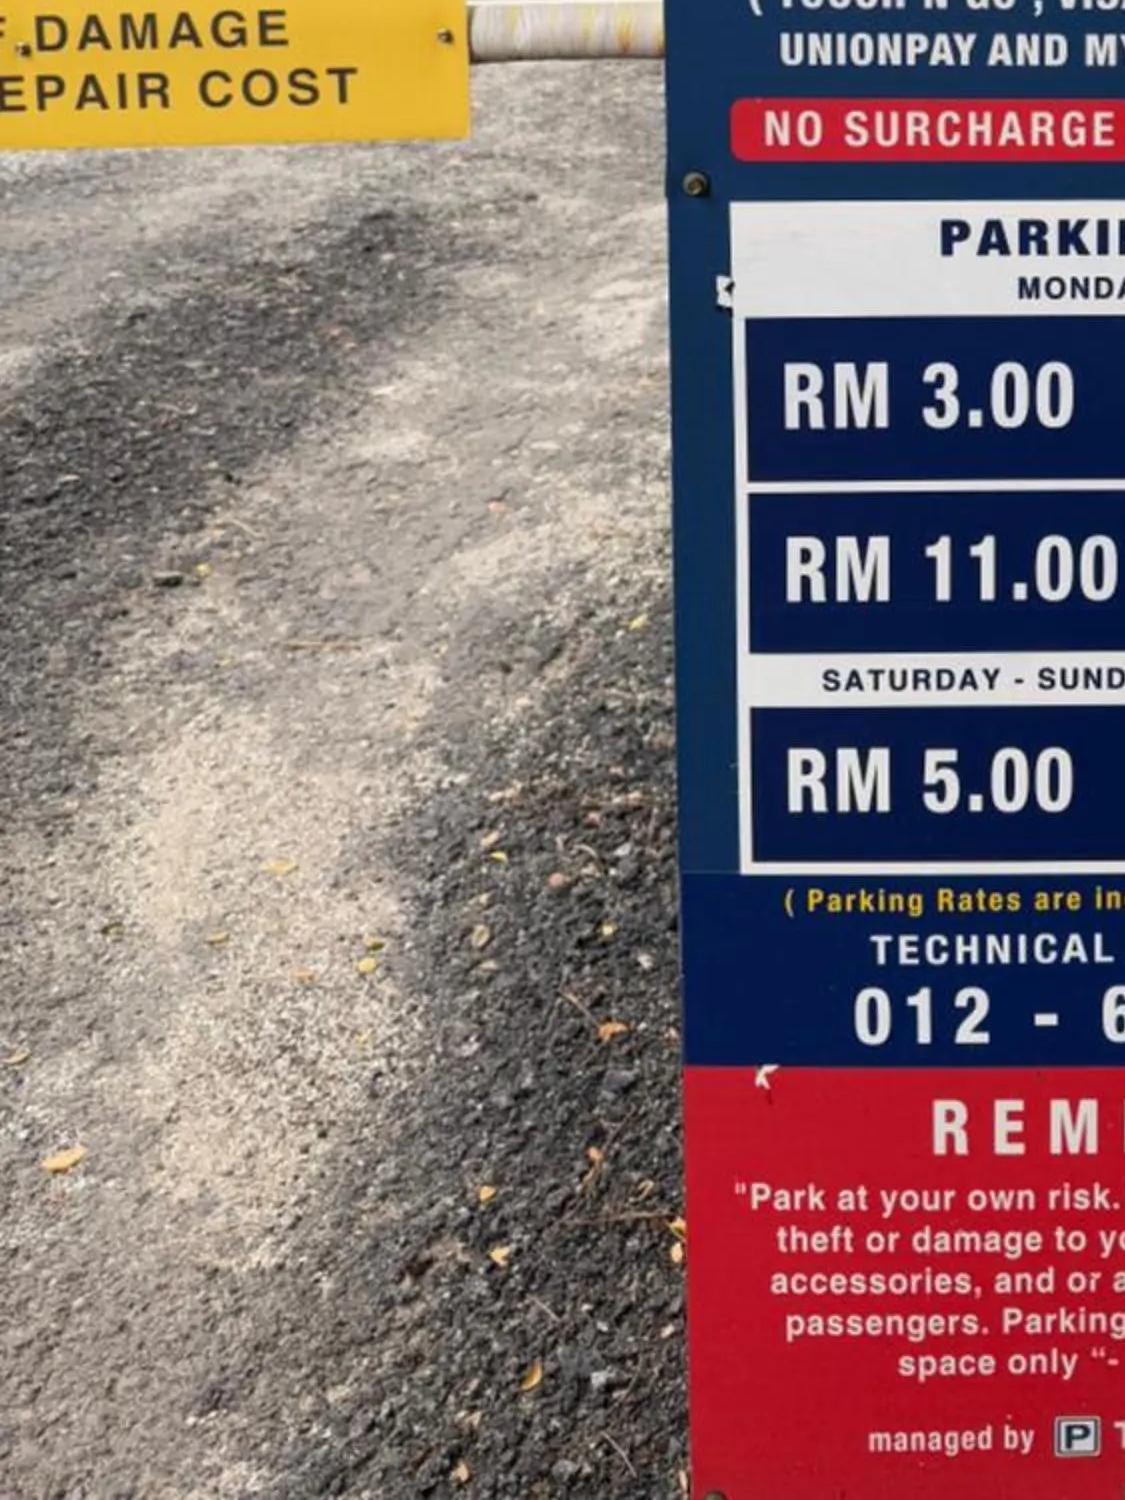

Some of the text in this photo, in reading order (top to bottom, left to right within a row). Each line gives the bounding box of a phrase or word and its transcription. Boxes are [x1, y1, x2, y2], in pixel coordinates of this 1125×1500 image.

[35, 10, 289, 52] DAMAGE
[780, 32, 977, 66] UNIONPAY
[987, 33, 1068, 67] AND
[198, 68, 357, 108] COST
[765, 110, 1115, 148] NO SURCHARGE
[783, 361, 1074, 430] RM 3.00
[786, 534, 1118, 603] RM 11.00
[822, 667, 1000, 692] SATURDAY
[787, 747, 1073, 814] RM 5.00
[807, 888, 923, 917] Parking
[937, 887, 1021, 912] Rates
[1034, 891, 1081, 911] are
[869, 932, 1115, 965] TECHNICAL
[854, 986, 990, 1046] 012
[837, 1185, 868, 1211] at
[880, 1189, 956, 1219] your
[967, 1189, 1035, 1211] own
[1048, 1182, 1120, 1211] risk.
[776, 1224, 854, 1253] theft
[865, 1231, 901, 1253] or
[911, 1225, 1043, 1260] damage
[1054, 1226, 1087, 1253] to
[770, 1266, 981, 1297] accessories,
[994, 1266, 1055, 1294] and
[1066, 1271, 1102, 1294] or
[786, 1313, 989, 1343] passengers.
[898, 1354, 996, 1383] space
[1007, 1347, 1078, 1381] only
[868, 1424, 1034, 1457] managed by
